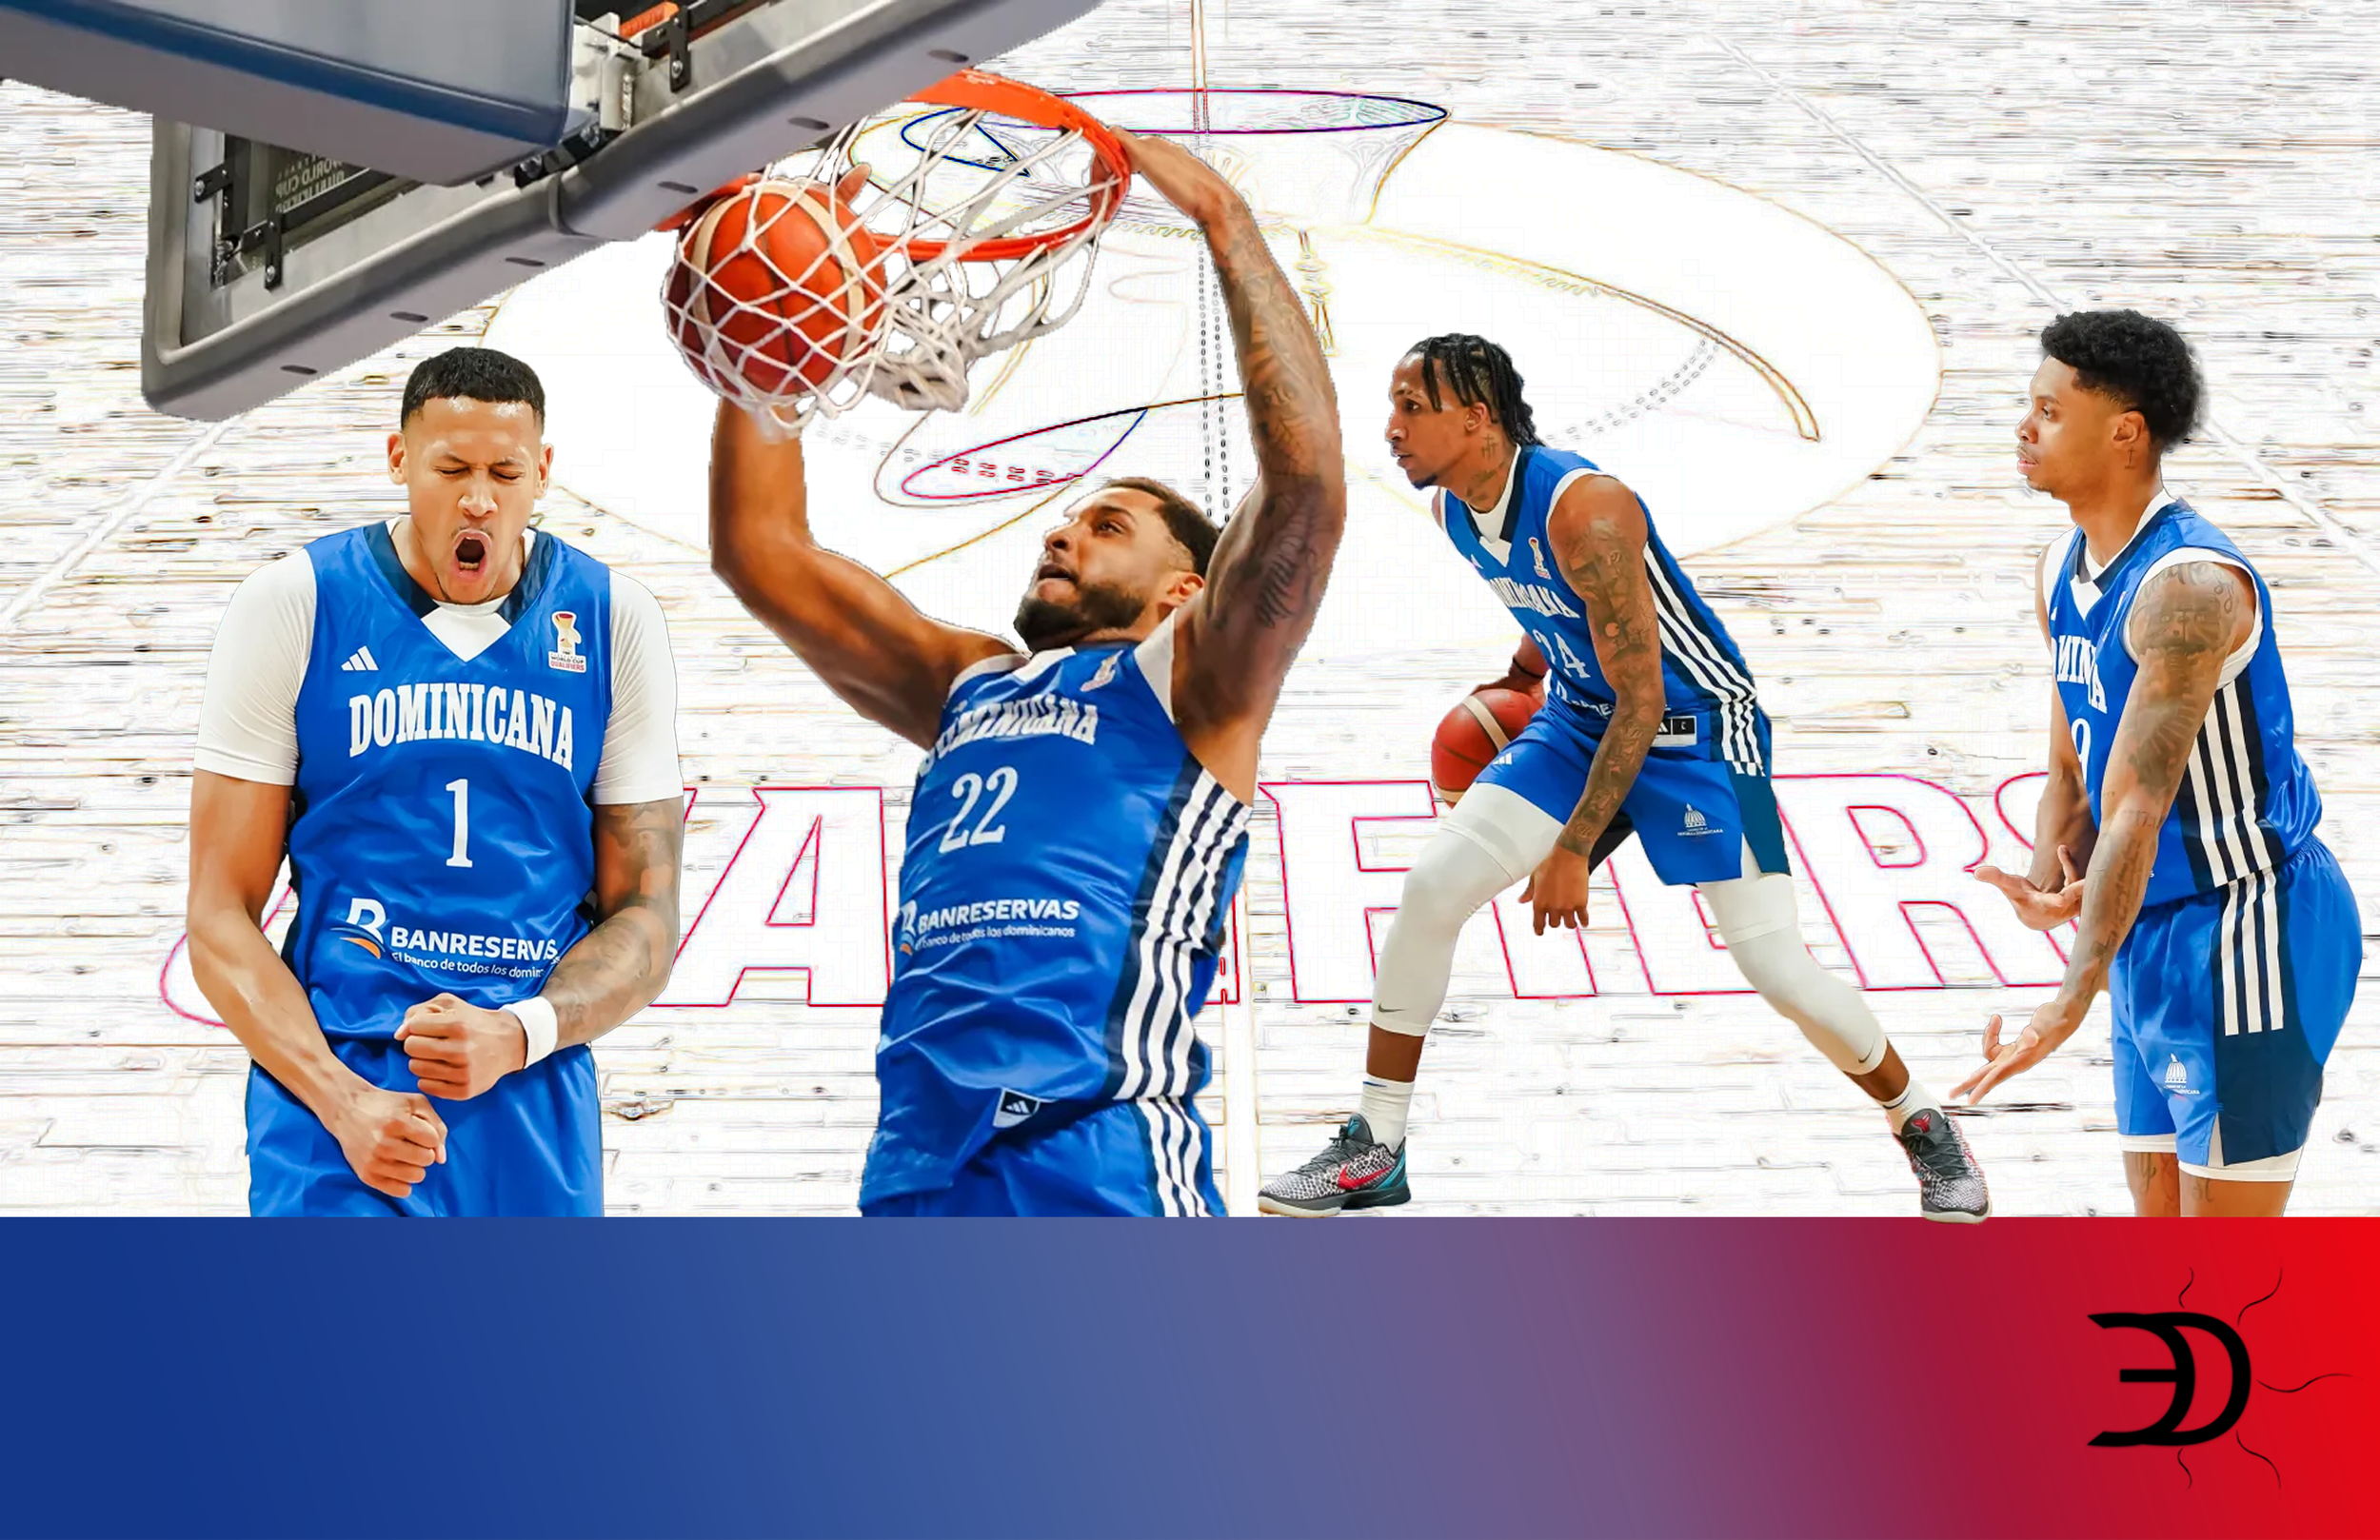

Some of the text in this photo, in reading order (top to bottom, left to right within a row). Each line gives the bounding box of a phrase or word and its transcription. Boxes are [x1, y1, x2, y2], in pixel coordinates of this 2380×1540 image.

[348, 682, 573, 773] DOMINICANA
[446, 778, 474, 869] 1
[938, 765, 1019, 855] 22
[918, 898, 1081, 936] BANRESERVAS
[1002, 924, 1076, 938] dominicanos
[404, 953, 439, 969] banco
[440, 958, 456, 971] de
[457, 960, 490, 974] todos
[490, 963, 508, 976] los
